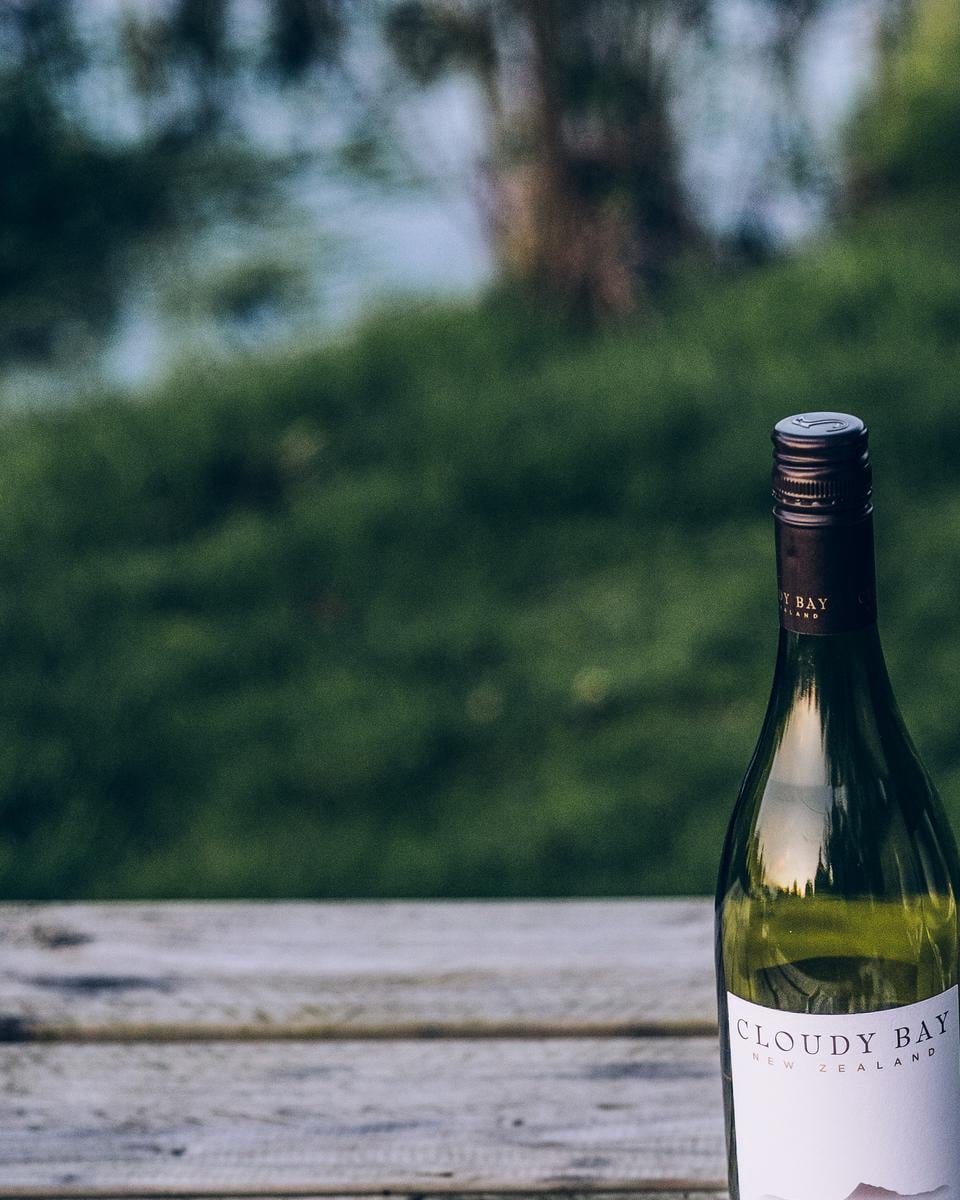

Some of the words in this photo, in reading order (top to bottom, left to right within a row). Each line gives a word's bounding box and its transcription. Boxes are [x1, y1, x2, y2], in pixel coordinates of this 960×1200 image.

[796, 595, 828, 610] BAY
[736, 1018, 876, 1056] CLOUDY
[894, 1010, 950, 1049] BAY
[752, 1052, 795, 1070] NEW
[819, 1047, 936, 1073] ZEALAND
